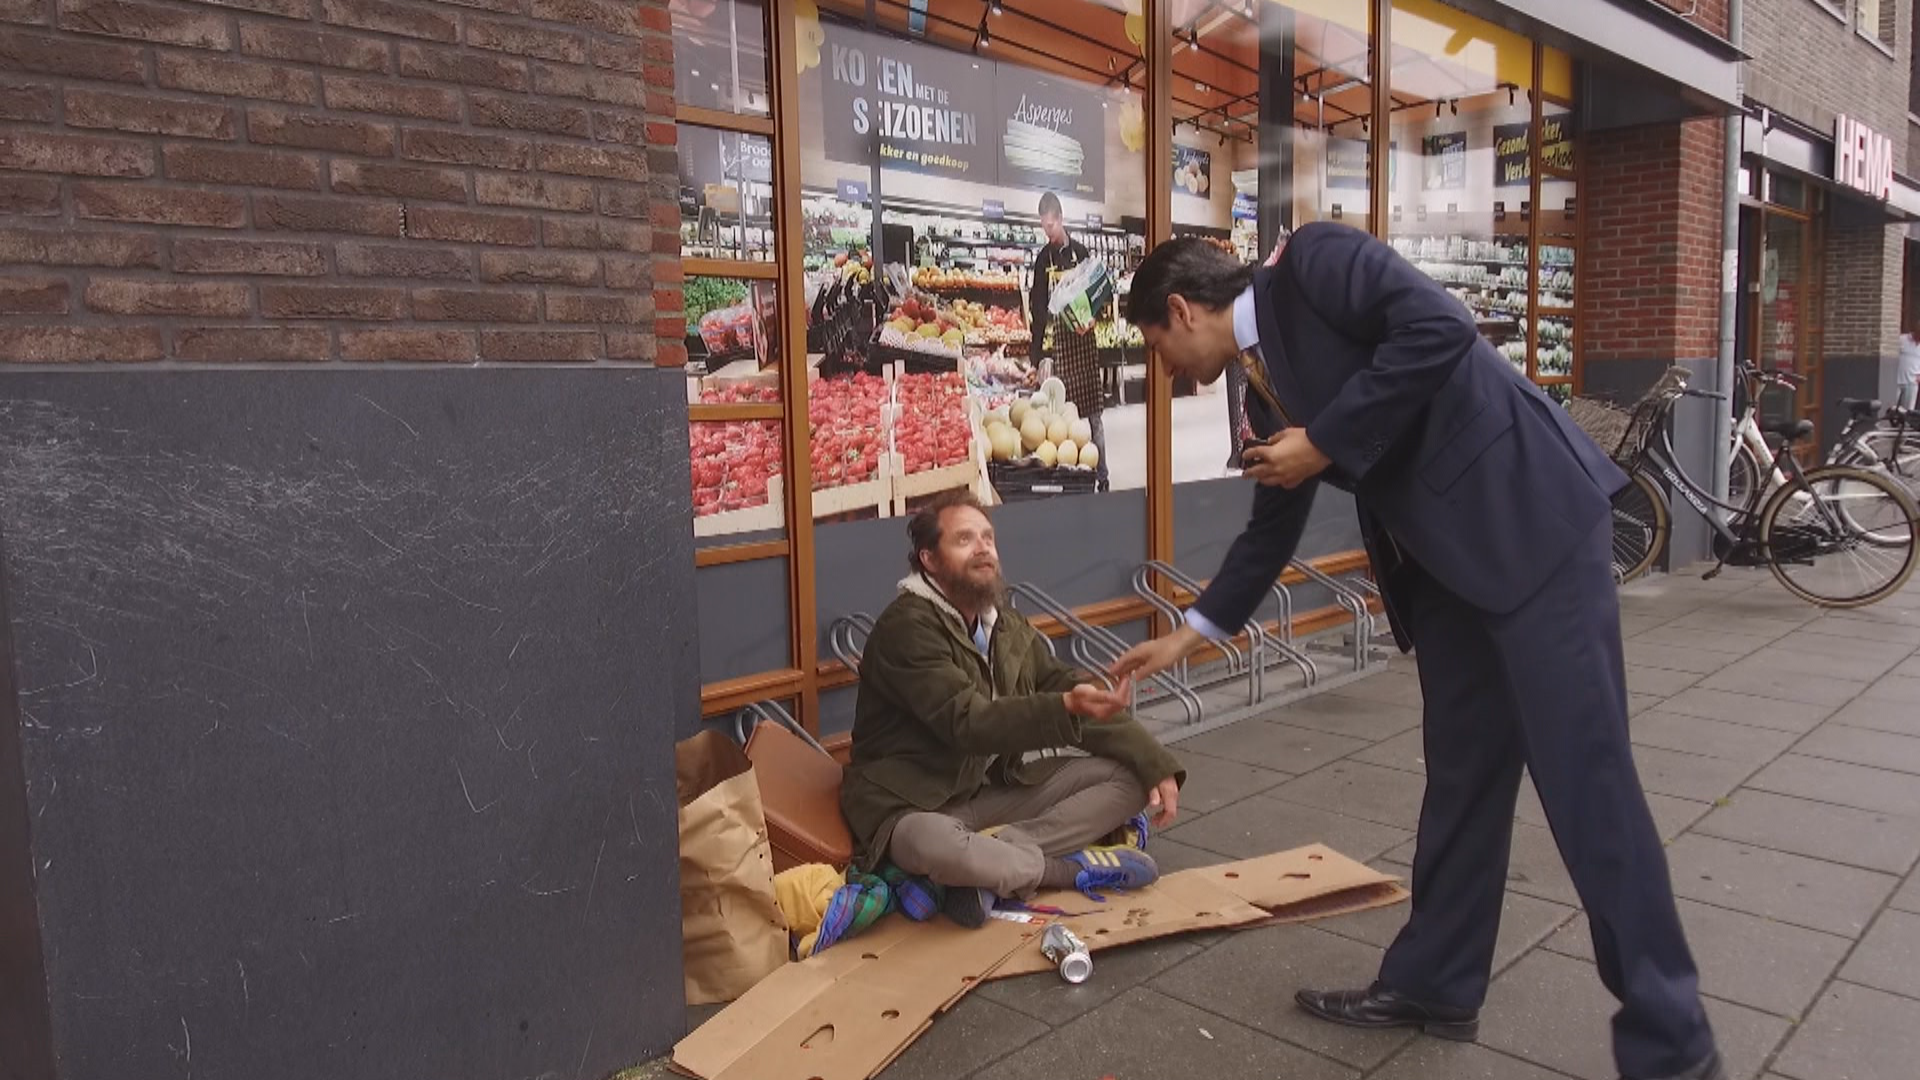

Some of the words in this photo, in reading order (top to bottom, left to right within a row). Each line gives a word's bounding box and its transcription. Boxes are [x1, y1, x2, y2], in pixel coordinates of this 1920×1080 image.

[832, 43, 912, 98] KOEN
[915, 83, 934, 101] MET
[938, 89, 949, 105] DE
[1014, 93, 1072, 137] Asperges
[906, 150, 920, 161] en
[921, 153, 969, 172] goedkoop
[1495, 129, 1530, 157] Gezond,
[1834, 113, 1892, 200] HEMA
[1505, 161, 1524, 182] Vers
